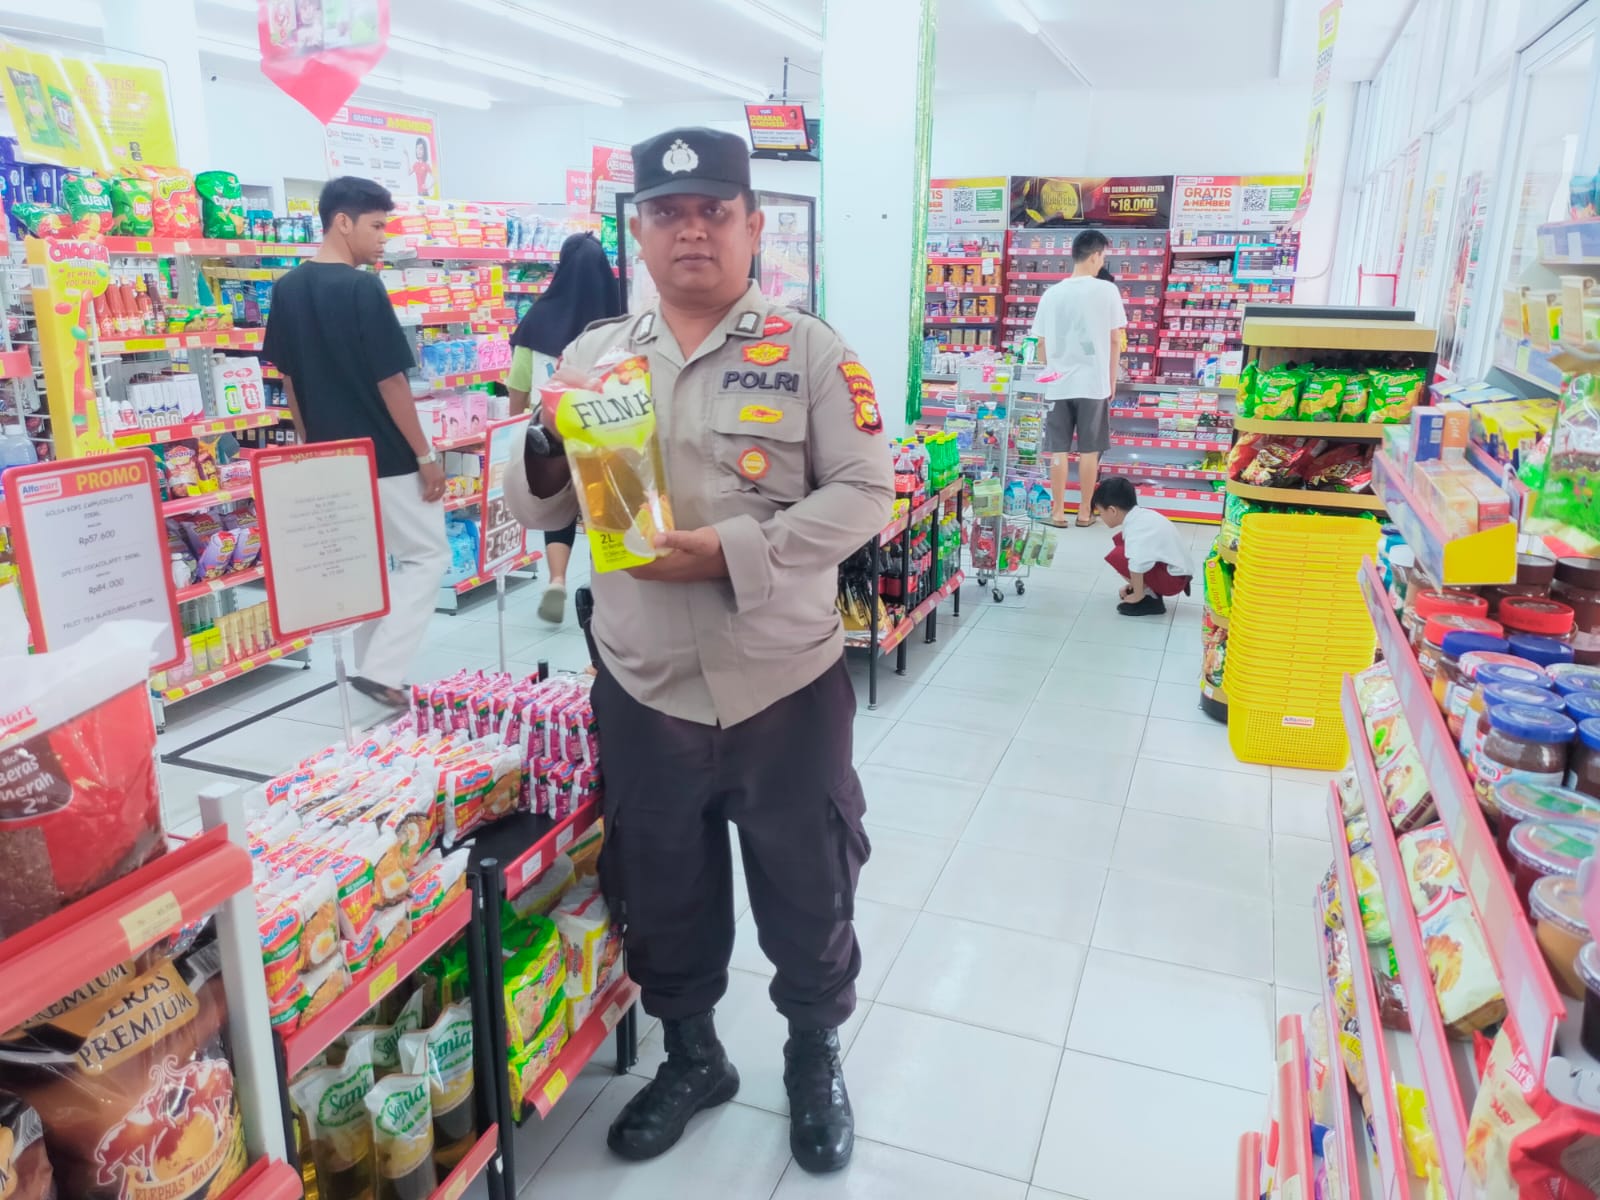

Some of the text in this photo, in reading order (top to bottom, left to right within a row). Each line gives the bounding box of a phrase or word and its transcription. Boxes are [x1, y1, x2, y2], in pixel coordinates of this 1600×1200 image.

[1183, 187, 1233, 198] GRATIS
[723, 371, 799, 392] POLRI
[76, 465, 142, 491] PROMO
[78, 992, 193, 1068] PREMIUM
